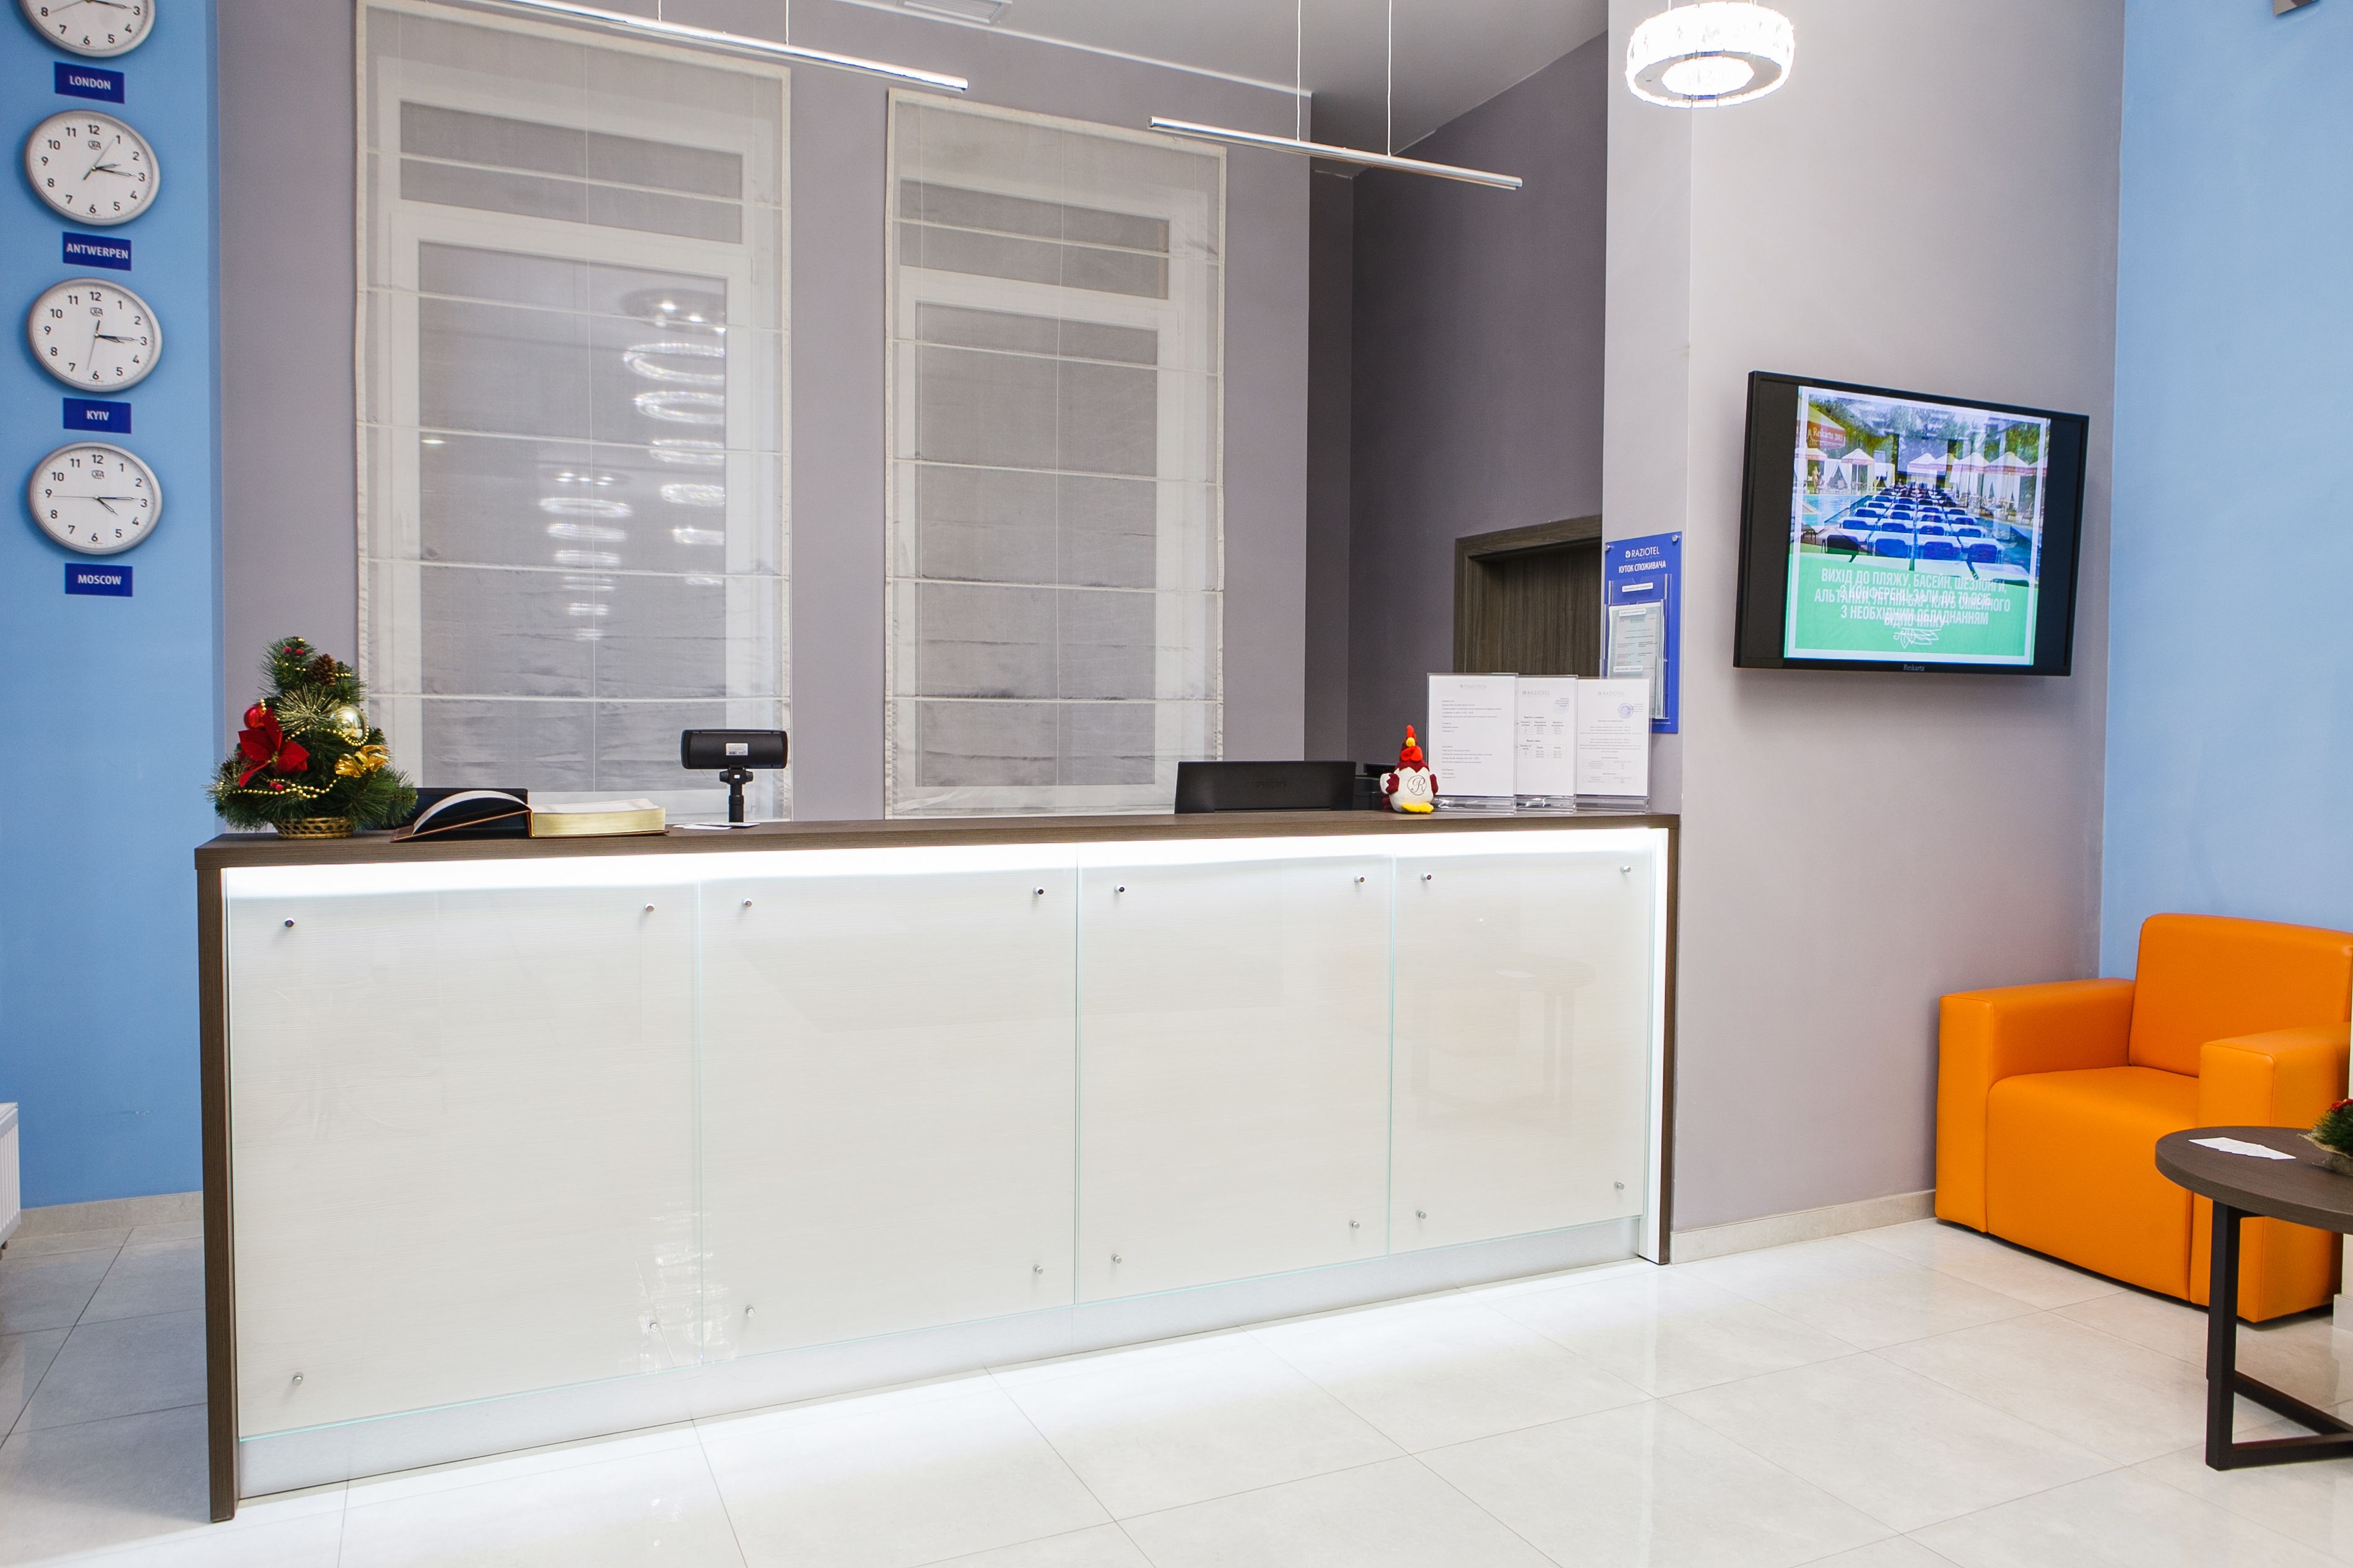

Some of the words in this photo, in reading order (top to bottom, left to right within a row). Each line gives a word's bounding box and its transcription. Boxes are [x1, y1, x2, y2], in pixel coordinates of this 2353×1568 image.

[41, 6, 49, 17] 8
[133, 6, 141, 16] 3
[58, 24, 67, 35] 7
[124, 24, 133, 33] 4
[83, 35, 90, 46] 6
[107, 33, 115, 44] 5
[69, 75, 111, 90] LONDON
[65, 126, 77, 137] 11
[87, 124, 100, 136] 12
[47, 139, 61, 150] 10
[115, 134, 121, 145] 1
[41, 156, 50, 167] 9
[131, 151, 140, 161] 2
[47, 177, 56, 188] 8
[137, 172, 146, 182] 3
[64, 194, 73, 204] 7
[129, 190, 138, 201] 4
[89, 204, 97, 214] 6
[113, 201, 121, 212] 5
[66, 243, 129, 259] ANTWERPEN
[67, 295, 79, 306] 11
[89, 291, 102, 302] 12
[117, 300, 123, 310] 1
[50, 308, 63, 319] 10
[134, 316, 141, 326] 2
[43, 325, 52, 336] 9
[140, 336, 147, 347] 3
[50, 346, 58, 357] 8
[132, 354, 140, 365] 4
[68, 362, 77, 373] 7
[116, 366, 123, 376] 5
[92, 370, 100, 380] 6
[86, 410, 110, 422] KYIV
[69, 457, 80, 468] 11
[92, 454, 104, 464] 12
[119, 462, 124, 472] 1
[51, 472, 64, 482] 10
[135, 477, 142, 488] 2
[45, 488, 53, 499] 9
[140, 498, 148, 508] 3
[50, 509, 58, 519] 8
[131, 516, 140, 526] 4
[67, 524, 76, 535] 7
[115, 529, 123, 539] 5
[90, 532, 99, 542] 6
[1631, 546, 1660, 558] RAZIOTEL
[1618, 564, 1634, 574] КУТОК
[1634, 560, 1667, 572] СПОЖИВАЧА
[77, 574, 122, 586] MOSCOW
[1822, 568, 1853, 586] ВИХІД
[1855, 570, 1870, 586] ДО
[1872, 571, 1911, 587] ПЛЯЖУ,
[1913, 573, 1952, 590] БАСЕЙН,
